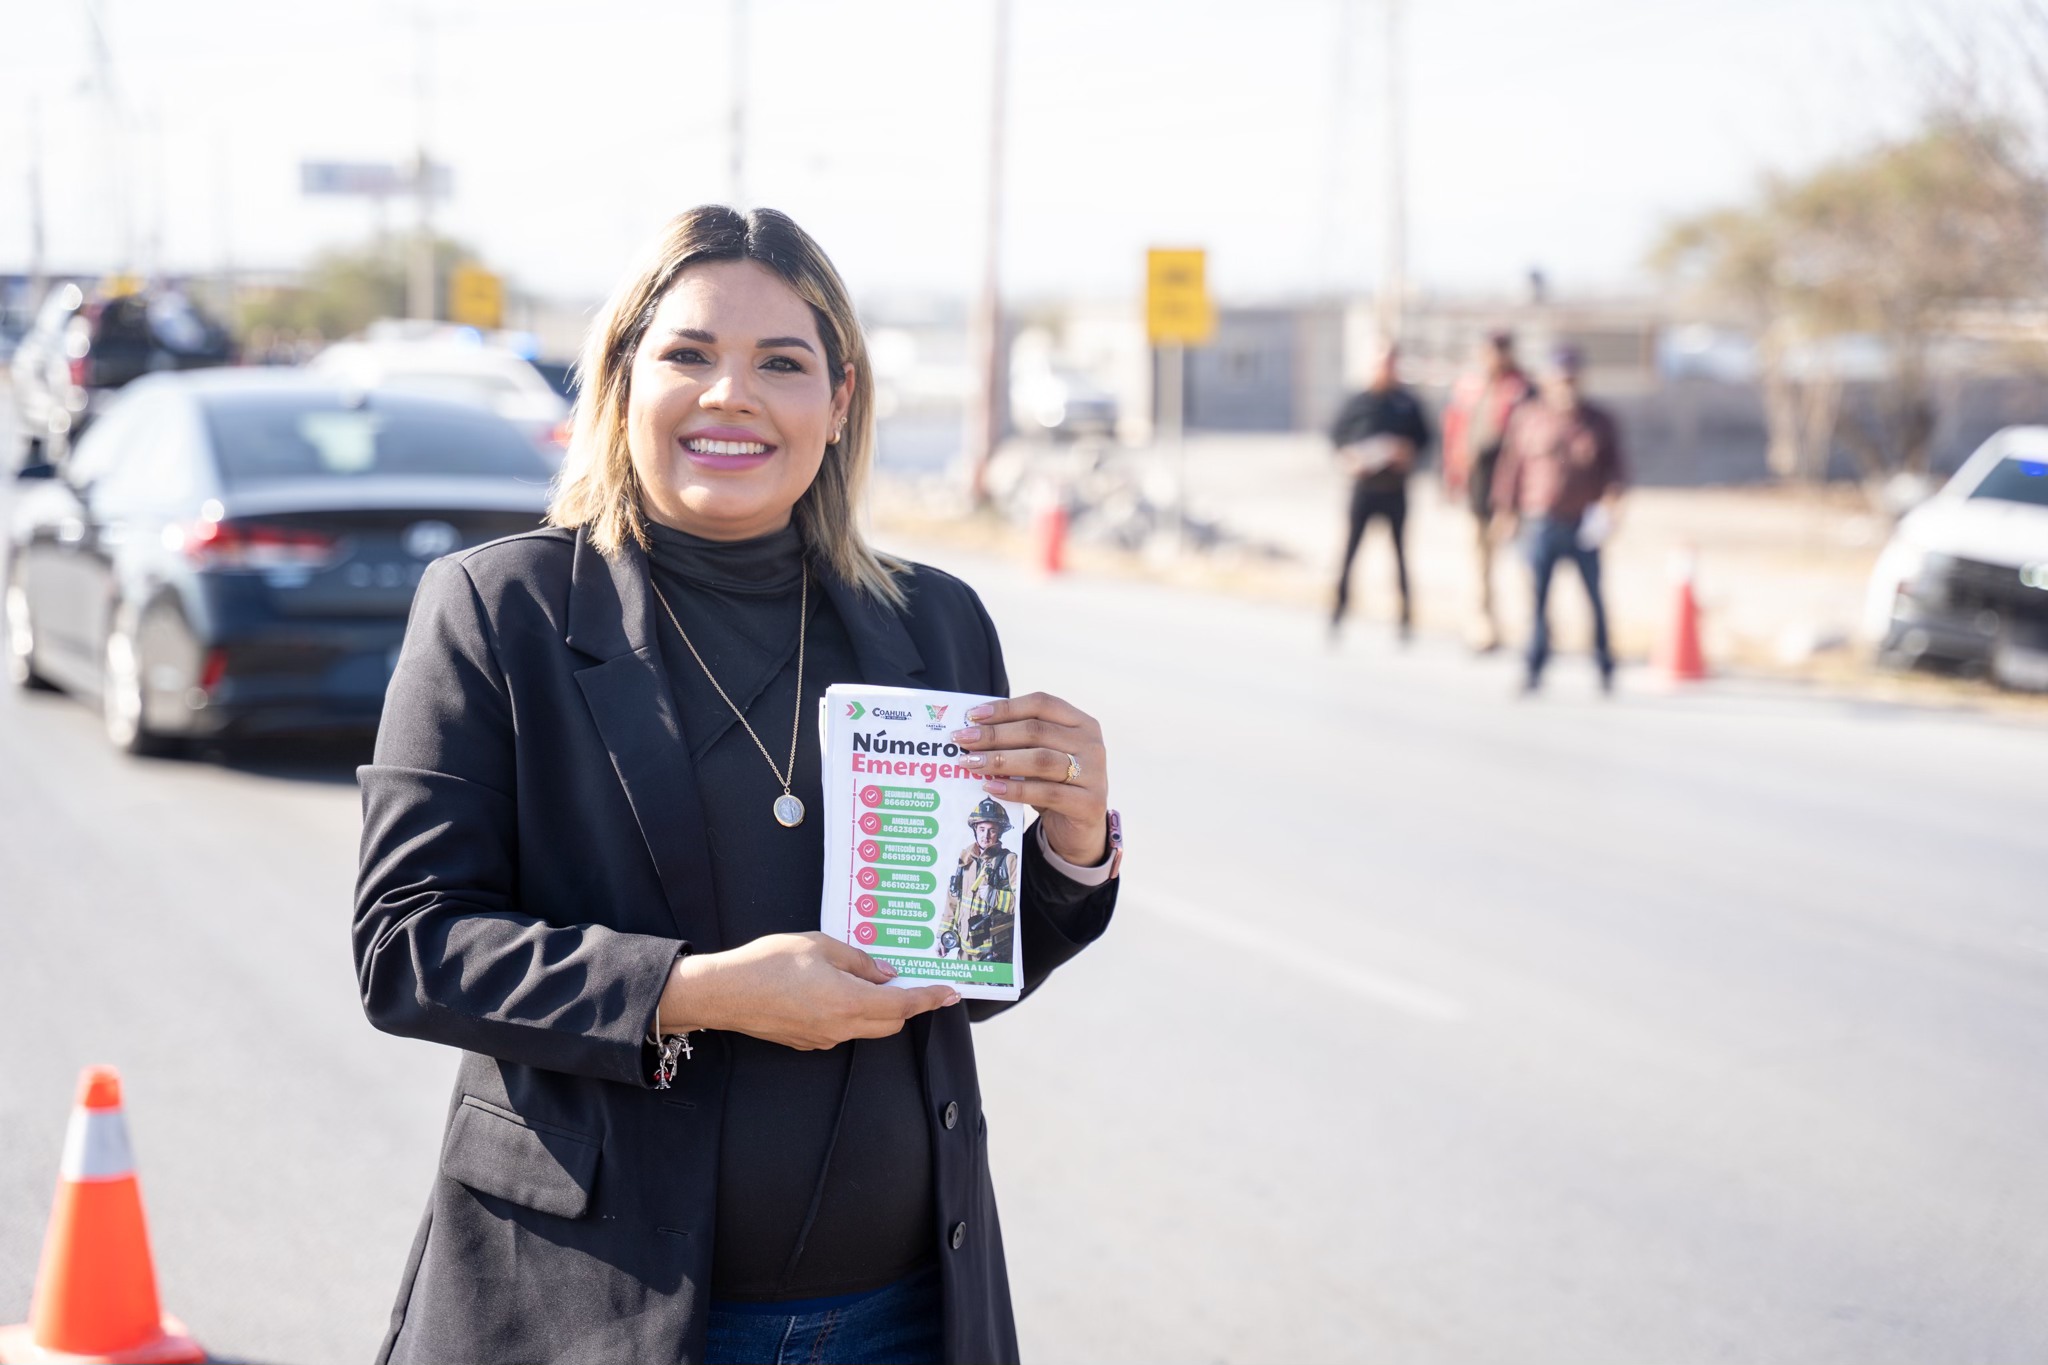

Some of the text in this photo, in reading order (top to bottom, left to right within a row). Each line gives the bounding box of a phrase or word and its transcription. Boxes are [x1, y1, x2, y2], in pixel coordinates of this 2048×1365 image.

[872, 707, 912, 717] COAHUILA
[852, 753, 1010, 783] Emergen
[884, 798, 934, 808] 8666970017
[882, 825, 932, 834] 8662388734
[881, 880, 930, 890] 8661026237
[898, 936, 910, 944] 911
[908, 959, 940, 970] AYUDA,
[941, 962, 970, 970] LLAMA
[978, 964, 994, 972] LAS
[918, 968, 972, 978] EMERGENCIA
